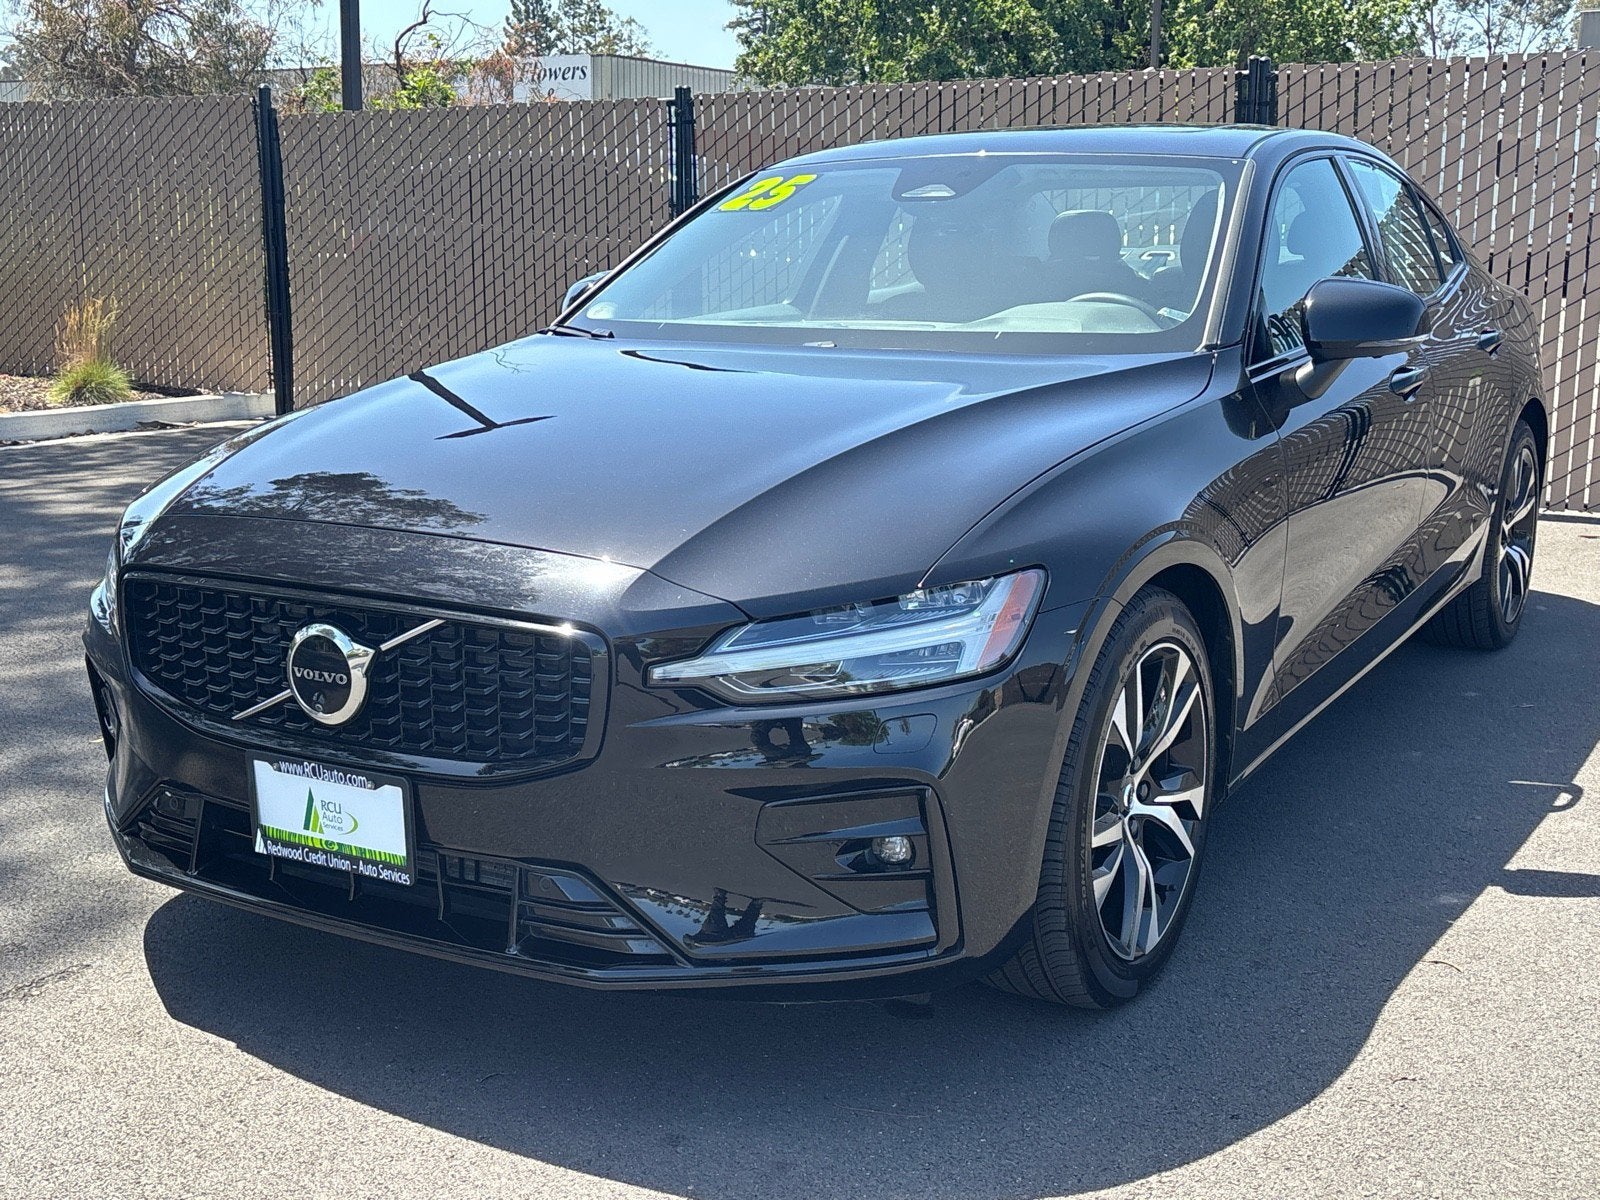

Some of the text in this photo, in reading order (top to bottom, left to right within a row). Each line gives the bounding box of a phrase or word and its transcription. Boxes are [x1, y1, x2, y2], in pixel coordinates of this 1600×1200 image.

[717, 173, 818, 212] 25
[293, 666, 348, 685] VOLVO
[279, 760, 368, 789] www.RCUauto.com
[320, 799, 342, 815] RCU
[322, 811, 343, 824] Auto
[322, 821, 344, 832] Services
[266, 840, 303, 861] Redwood
[303, 848, 327, 866] Credit
[327, 855, 351, 872] Union
[358, 860, 378, 877] Auto
[378, 864, 410, 885] Services
